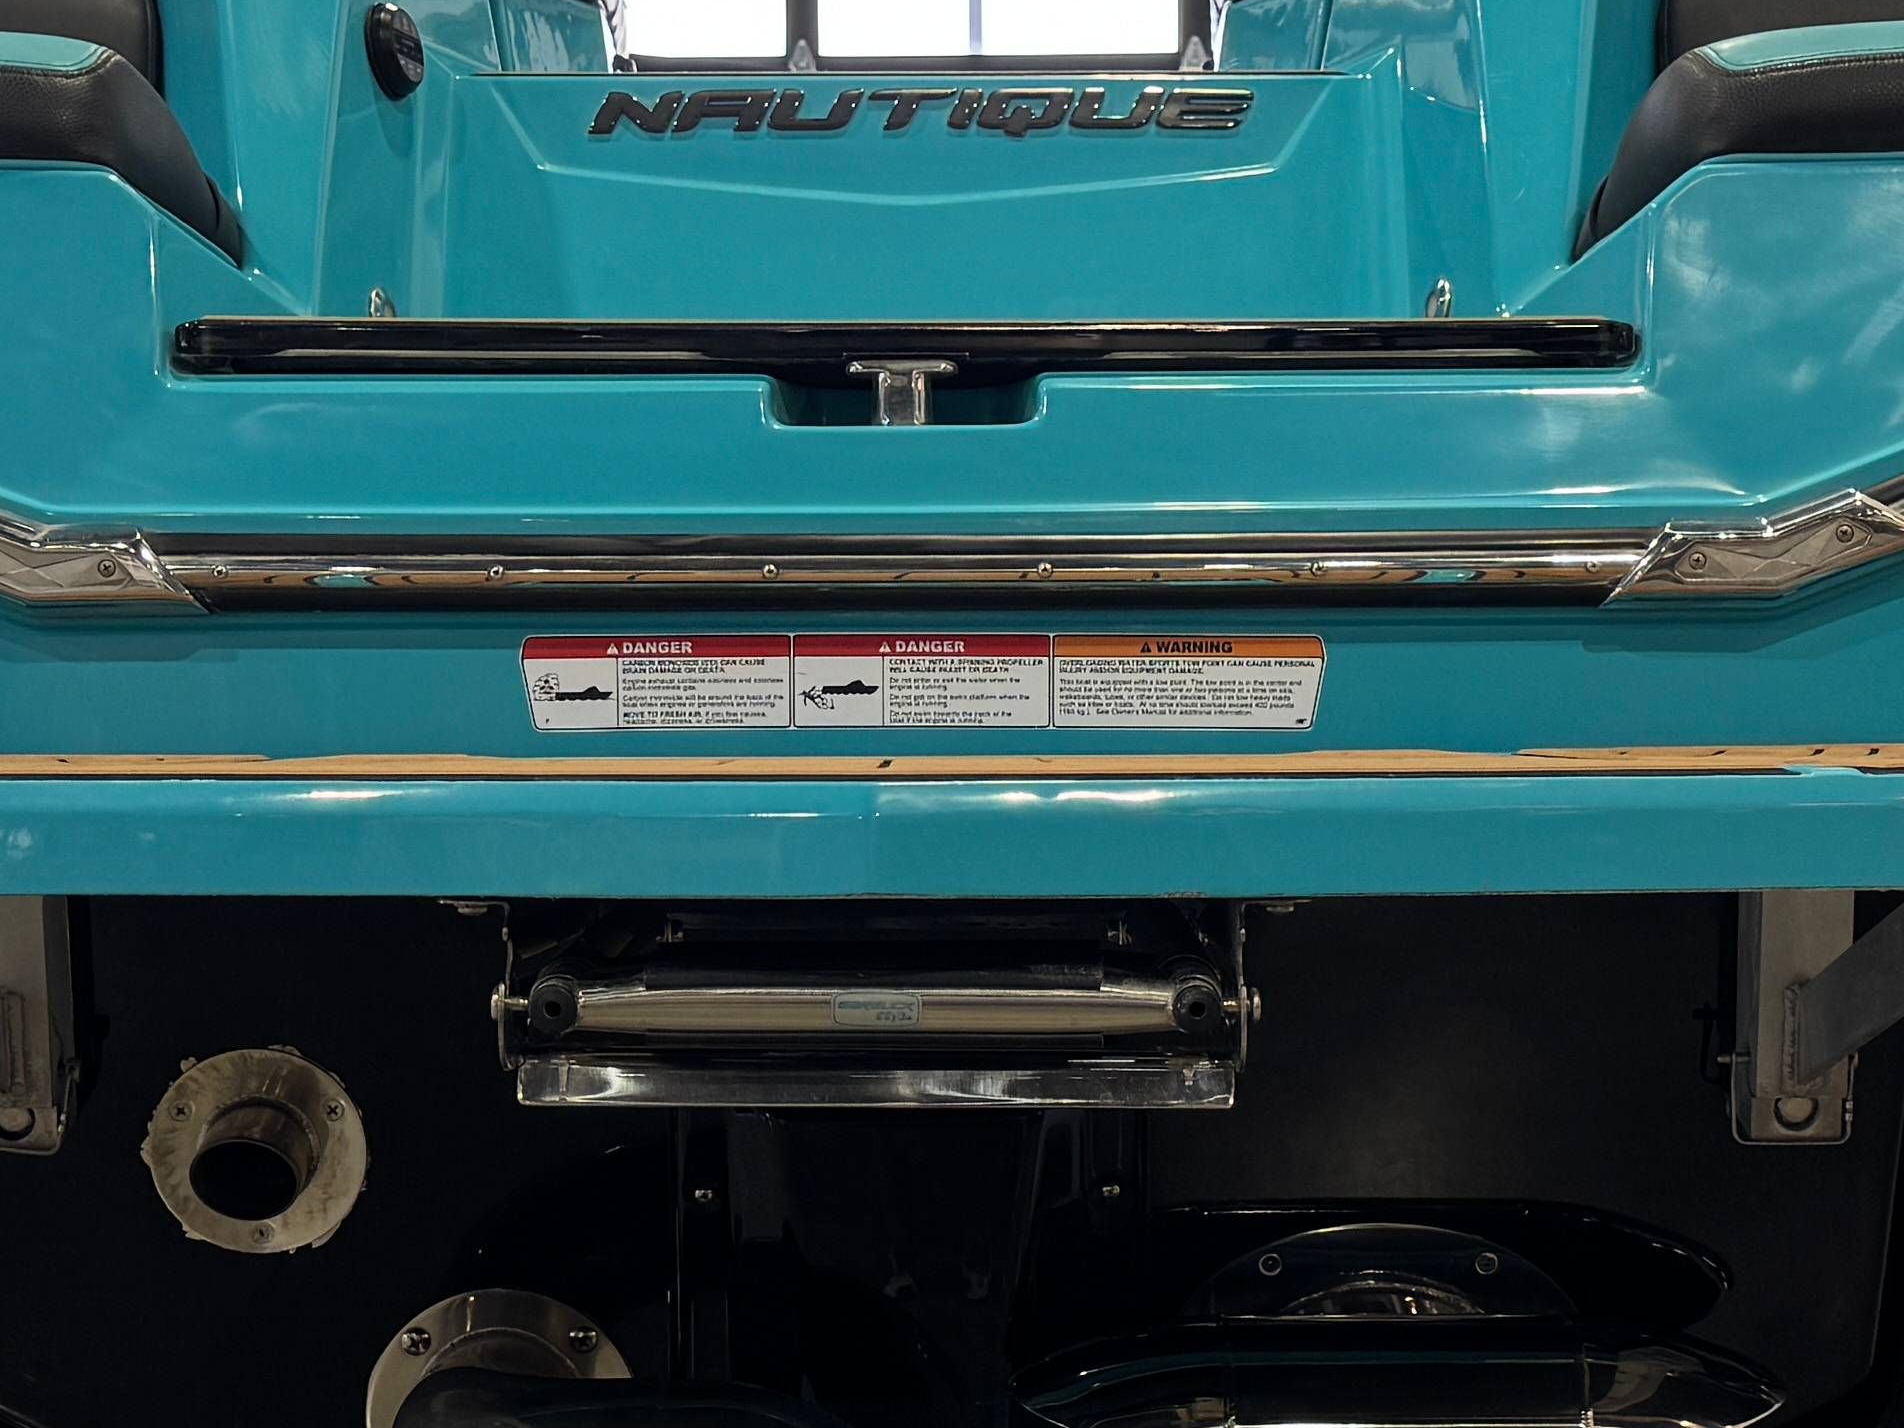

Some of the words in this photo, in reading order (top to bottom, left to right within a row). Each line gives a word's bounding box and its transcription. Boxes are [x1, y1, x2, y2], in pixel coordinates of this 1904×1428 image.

[587, 85, 1256, 139] NAUTIQUE
[622, 641, 693, 654] DANGER
[895, 640, 966, 653] DANGER
[1156, 641, 1233, 654] WARNING
